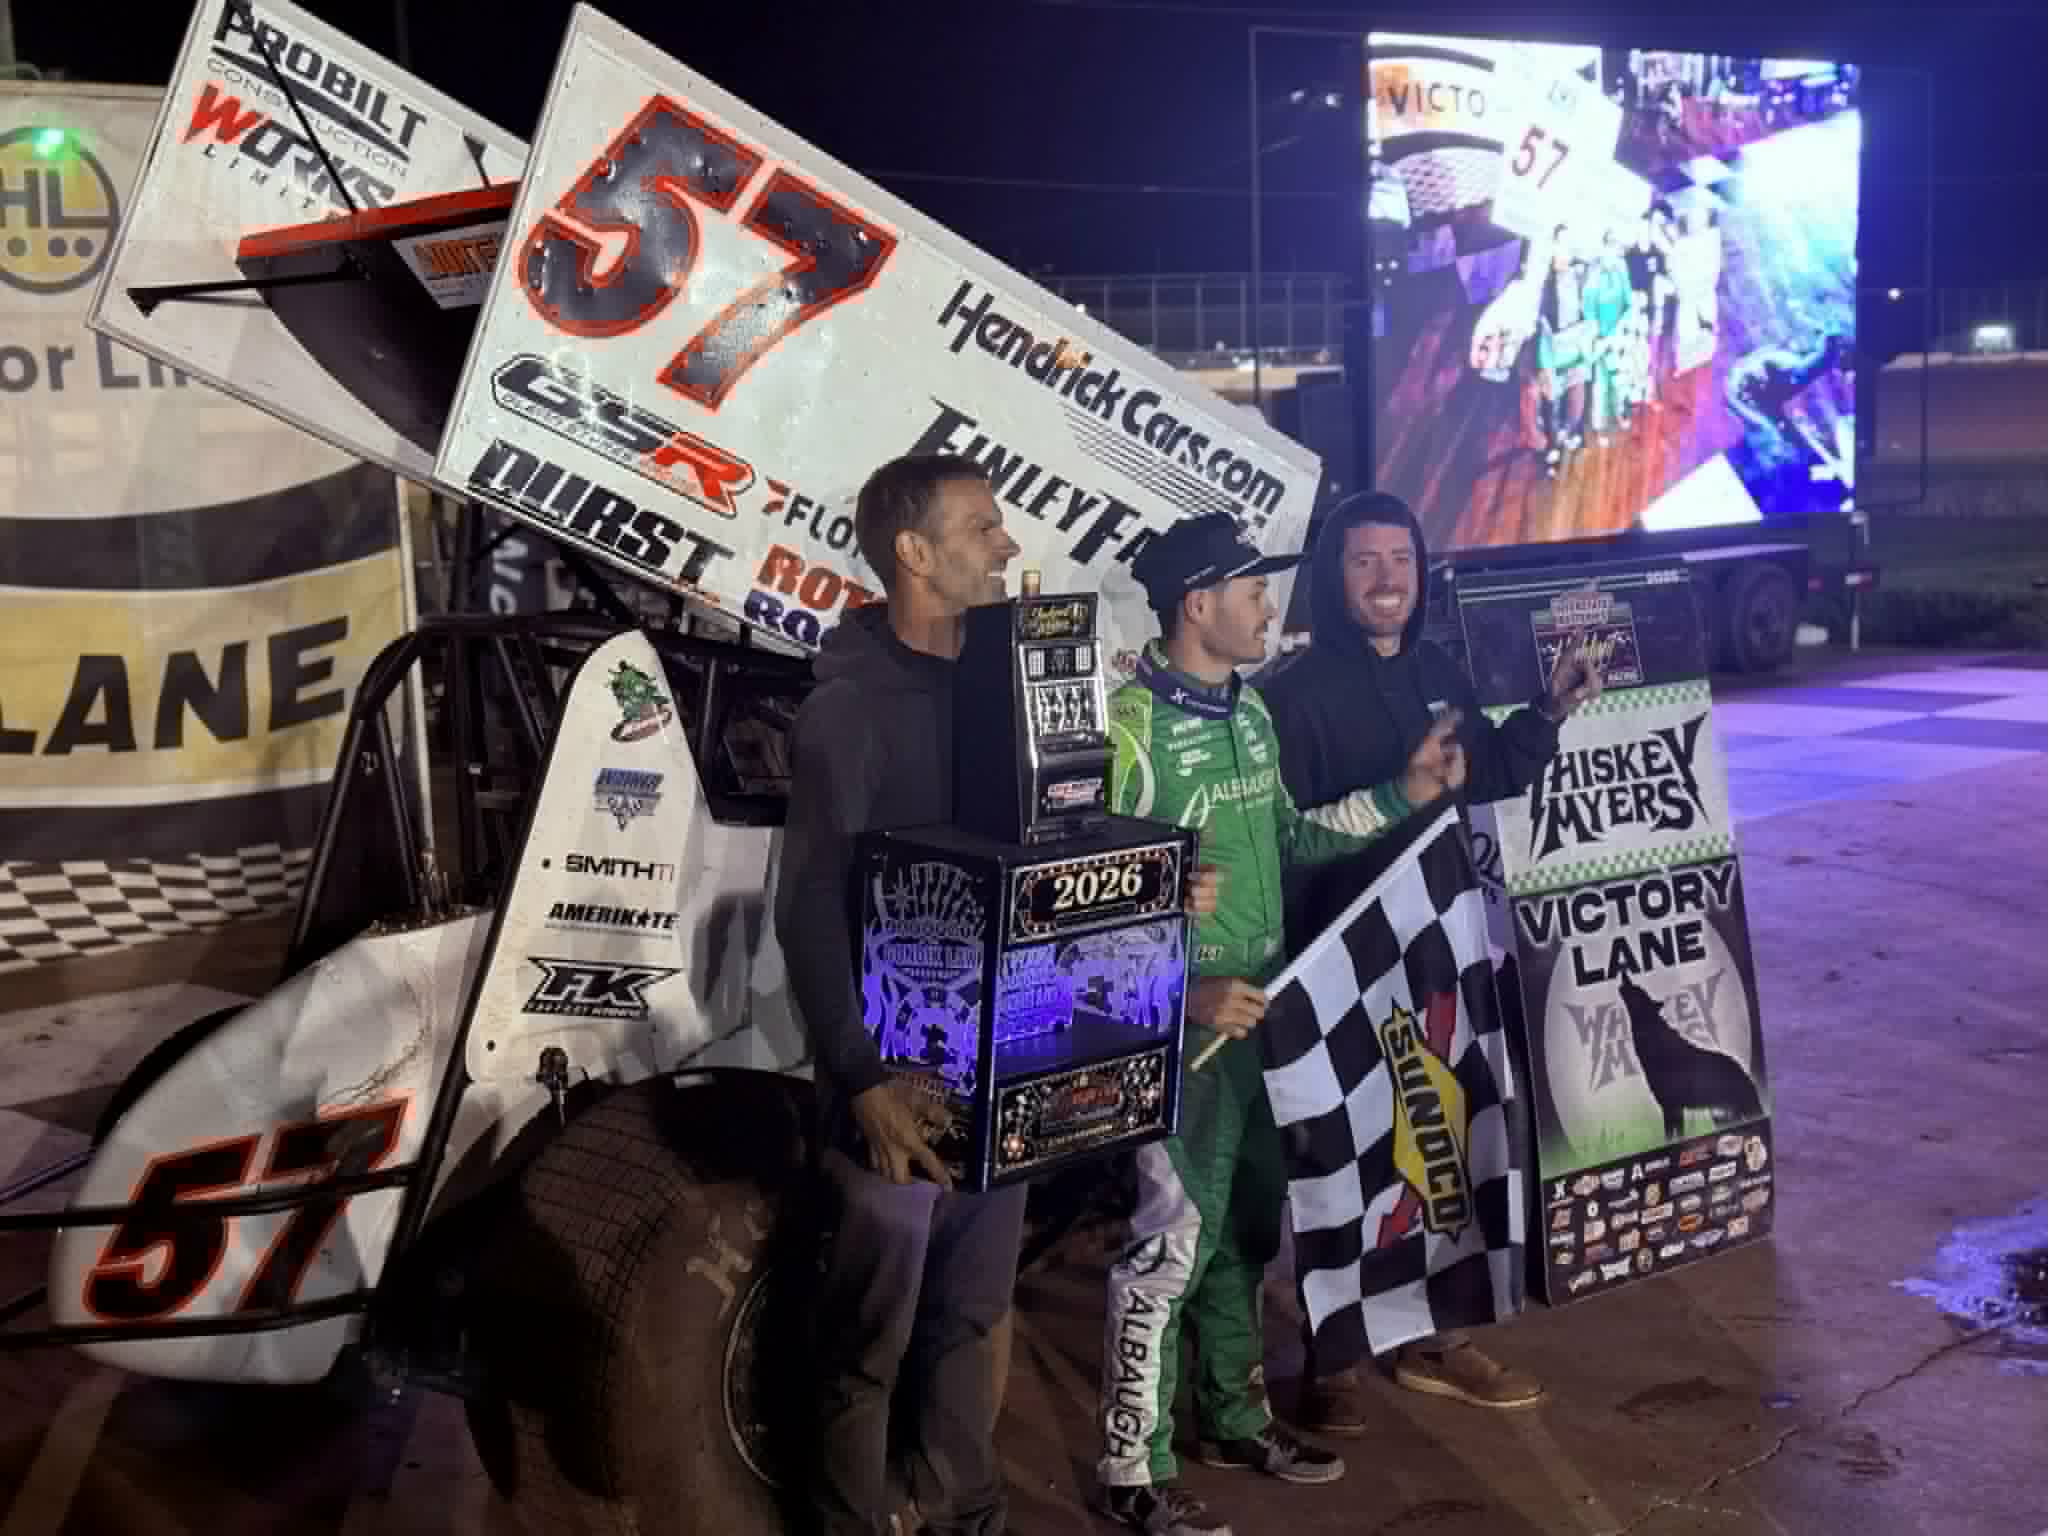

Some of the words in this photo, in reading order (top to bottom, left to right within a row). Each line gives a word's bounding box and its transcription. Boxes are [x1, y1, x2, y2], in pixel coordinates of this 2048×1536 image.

[207, 57, 408, 177] CONSUCTION
[1512, 125, 1569, 190] 57
[203, 143, 342, 218] LIMIT
[517, 94, 898, 411] 57
[937, 280, 1285, 515] HendrickCars.com
[467, 439, 736, 587] DURST
[783, 494, 866, 559] FLO
[1534, 778, 1695, 864] MYERS
[1053, 865, 1144, 910] 2026
[1519, 863, 1734, 946] VICTORY
[1571, 919, 1706, 988] LANE
[1387, 1019, 1469, 1228] SUNOCO
[81, 1097, 410, 1318] 57
